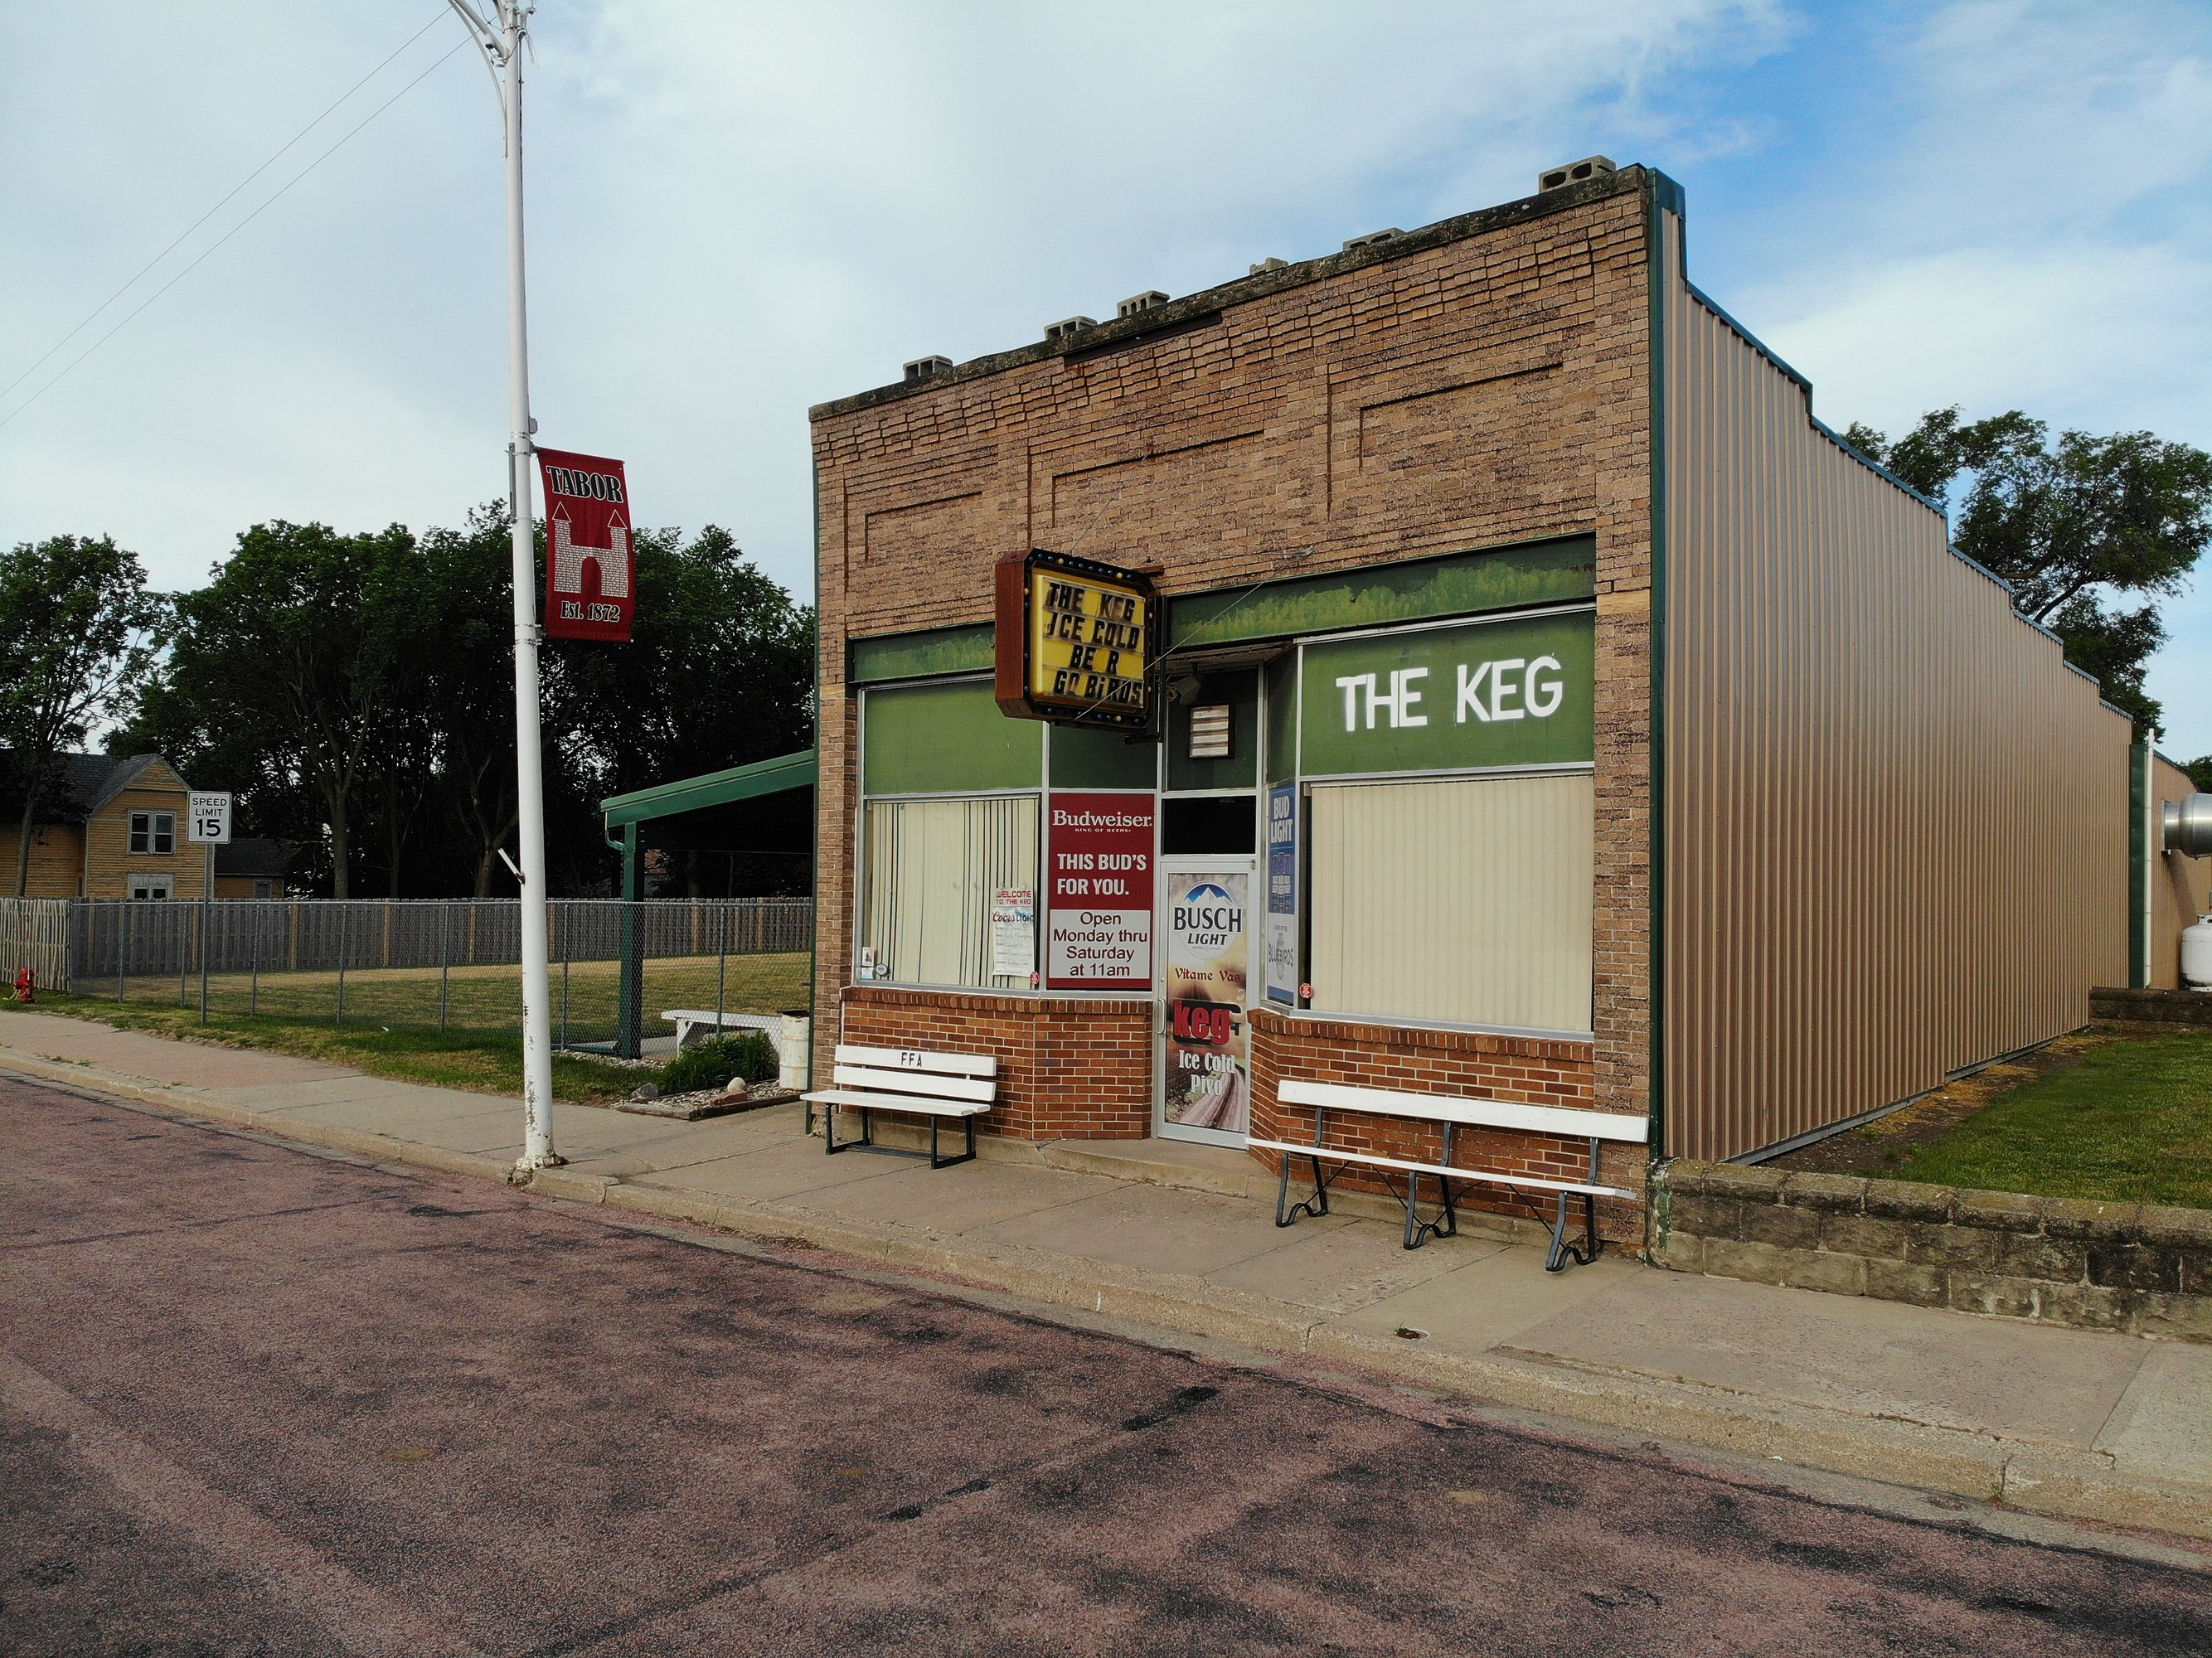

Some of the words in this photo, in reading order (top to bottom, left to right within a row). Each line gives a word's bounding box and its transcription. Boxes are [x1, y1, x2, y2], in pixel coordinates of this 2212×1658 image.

[546, 465, 623, 503] TABOR
[1049, 582, 1085, 613] THE
[560, 600, 584, 619] Est.
[587, 602, 620, 622] 1872
[1045, 612, 1085, 642] ICE
[1093, 619, 1141, 649] COLD
[1053, 670, 1080, 695] GO
[1336, 667, 1429, 732] THE
[1456, 656, 1564, 723] KEG
[192, 797, 227, 807] SPEED
[196, 808, 223, 817] LIMIT
[1273, 796, 1290, 819] BUD
[196, 818, 221, 837] 15
[1270, 819, 1293, 843] LIGHT
[1057, 854, 1094, 870] THIS
[1099, 854, 1147, 870] BUD'S
[1057, 879, 1089, 894] FOR
[1093, 879, 1129, 895] YOU.
[992, 911, 1016, 923] Coors
[1080, 911, 1122, 928] Open
[1173, 907, 1243, 933] BUSCH
[1053, 928, 1114, 945] Monday
[1118, 929, 1148, 943] thru
[1187, 933, 1228, 946] LIGHT
[1066, 946, 1135, 962] Saturday
[1269, 943, 1293, 968] BLUEBIRDS
[1070, 963, 1084, 977] at
[1089, 963, 1130, 977] 11am
[1173, 999, 1231, 1045] keg
[900, 1052, 923, 1068] FFA
[1178, 1050, 1200, 1069] Ice
[1205, 1052, 1236, 1074] Cold
[1191, 1074, 1223, 1096] Pivo
